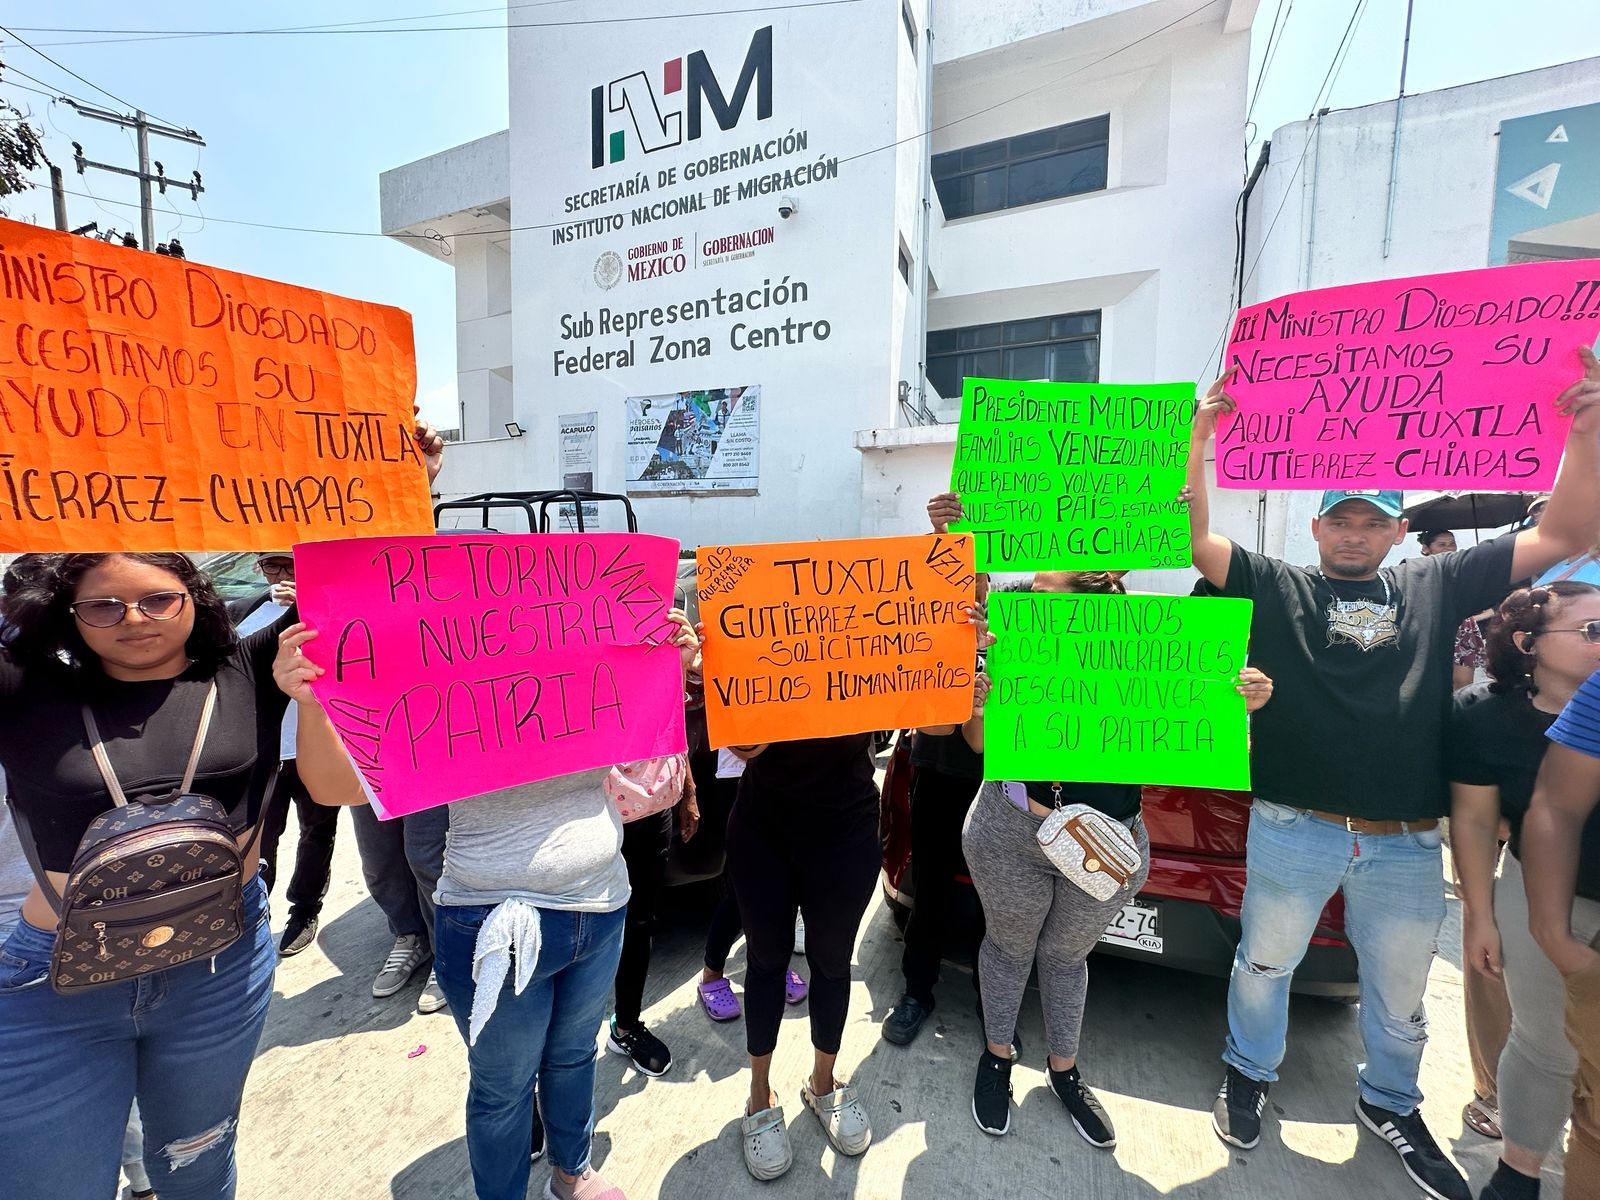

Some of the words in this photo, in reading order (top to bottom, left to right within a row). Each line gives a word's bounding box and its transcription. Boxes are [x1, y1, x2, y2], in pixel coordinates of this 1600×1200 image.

[564, 172, 651, 213] SECRETARÍA
[658, 167, 677, 188] DE
[683, 128, 808, 182] GOBERNACIÓN
[552, 213, 624, 246] INSTITUTO
[631, 192, 706, 226] NACIONAL
[713, 185, 731, 207] DE
[737, 153, 839, 202] MIGRACIÓN
[627, 240, 668, 260] GOBIERNO
[672, 236, 684, 251] DE
[560, 311, 594, 340] Sub
[599, 275, 808, 337] Representación
[554, 340, 635, 377] Federal
[650, 334, 711, 364] Zona
[731, 317, 831, 351] Centro
[1482, 333, 1550, 366] SU
[253, 356, 315, 402] SU
[1299, 370, 1444, 414] AYUDA
[215, 402, 285, 452] EN
[295, 410, 421, 466] TUXTLA
[560, 425, 596, 434] ACAPULCO
[1089, 394, 1194, 438] MADURO
[1316, 416, 1367, 441] EN
[1387, 402, 1543, 441] TUXTLA
[1048, 429, 1190, 469] VENEZOLANAS
[957, 469, 1052, 499] QUEREMOS
[1061, 469, 1128, 495] VOLVER
[1136, 474, 1151, 495] A
[1121, 500, 1190, 517] ESTAMOS
[925, 536, 975, 593] VZLA
[971, 529, 1061, 564] TUXTLA
[371, 541, 597, 603] RETORNO
[698, 555, 743, 602] QUEREMOS
[718, 557, 756, 594] VOLVER
[773, 557, 914, 597] TUXTLA
[336, 618, 377, 683] A
[418, 594, 616, 667] NUESTRA
[1075, 639, 1234, 674] VULNERABLES
[712, 675, 811, 707] VUELOS
[999, 676, 1098, 706] DESEAN
[1115, 677, 1206, 711] VOLVER
[385, 662, 625, 770] PATRIA
[1014, 712, 1027, 752] A
[1046, 711, 1081, 751] SU
[1100, 715, 1215, 753] PATRIA
[103, 886, 128, 900] OH
[180, 866, 203, 883] OH
[169, 949, 194, 965] OH
[1142, 939, 1158, 948] KIA
[89, 971, 116, 984] OH
